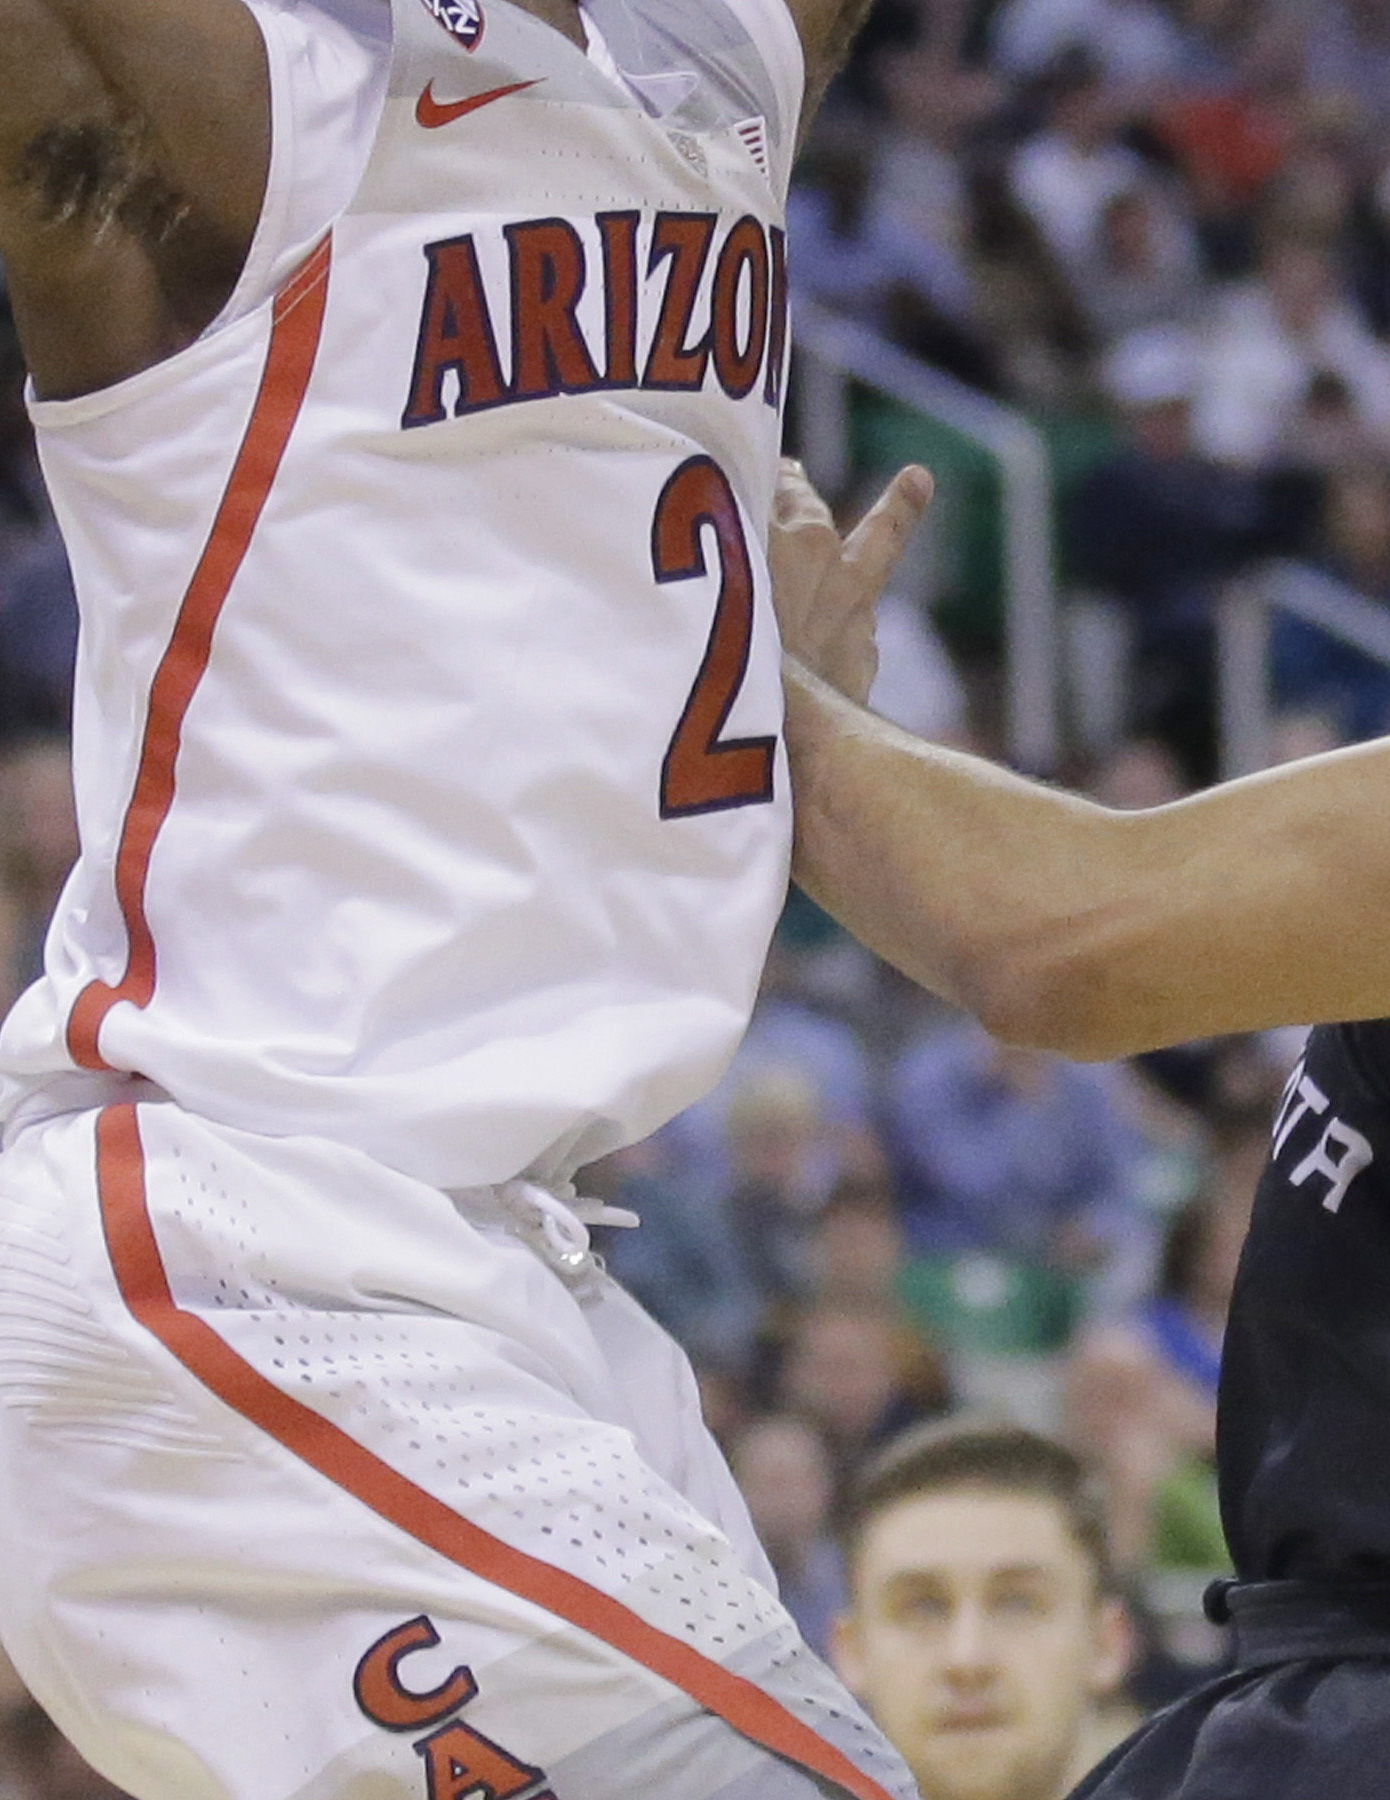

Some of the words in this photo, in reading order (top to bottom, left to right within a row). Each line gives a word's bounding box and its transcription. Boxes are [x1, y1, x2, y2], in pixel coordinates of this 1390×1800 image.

[440, 5, 478, 35] 12
[650, 453, 778, 821] 2
[1271, 1058, 1374, 1215] TA
